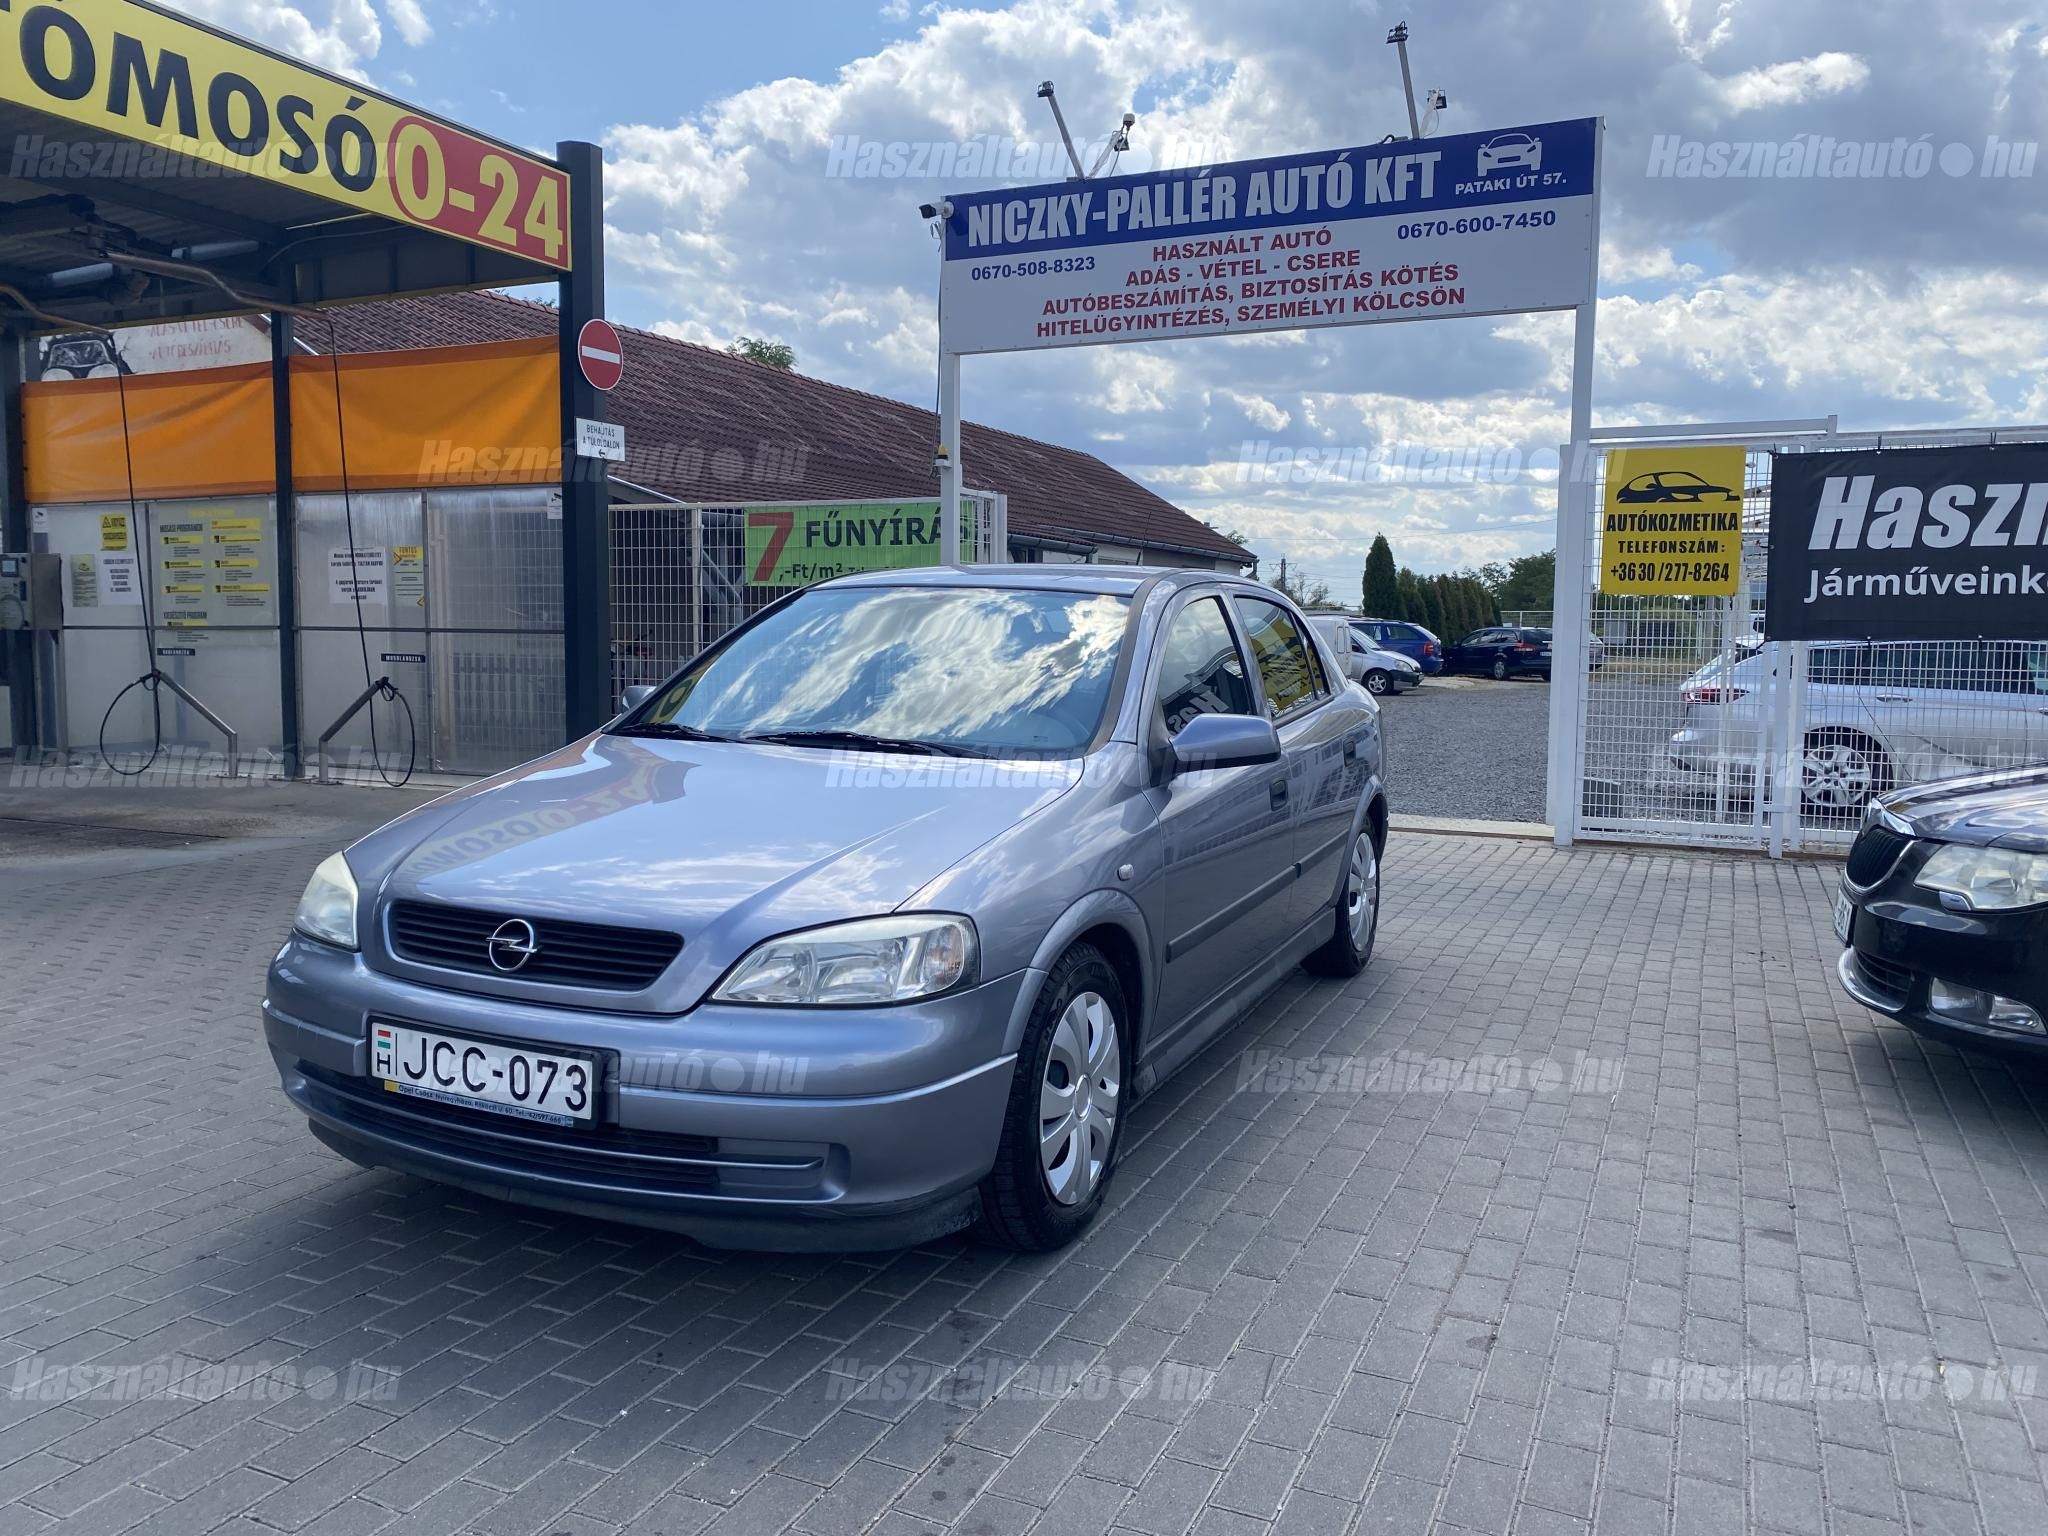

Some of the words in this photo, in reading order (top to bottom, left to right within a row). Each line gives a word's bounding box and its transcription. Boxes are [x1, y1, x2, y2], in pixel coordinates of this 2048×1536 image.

[968, 169, 1237, 248] NICZKY-PALLÉR
[1245, 152, 1353, 217] AUTÓ
[1365, 151, 1442, 205] KFT
[1455, 178, 1511, 195] PATAKI
[1516, 174, 1537, 189] ÚT
[1542, 172, 1567, 185] 57.
[1153, 234, 1264, 262] HASZNÁLT
[1270, 225, 1332, 251] AUTÓ
[1397, 209, 1556, 240] 0670-600-7450
[971, 256, 1096, 281] 0670-508-8323
[1126, 264, 1180, 287] ADÁS
[1200, 257, 1267, 281] VÉTEL
[1287, 249, 1360, 273] CSERE
[1043, 282, 1234, 316] AUTÓBESZÁMÍTÁS,
[1241, 269, 1372, 300] BIZTOSÍTÁS
[1381, 262, 1459, 287] KÖTÉS
[1037, 305, 1230, 338] HITELÜGYINTÉZÉS,
[1237, 297, 1345, 322] SZEMÉLYI
[1353, 287, 1465, 313] KÖLCSÖN
[1606, 510, 1739, 532] AUTÓKOZMETIKA
[749, 511, 794, 582] 7
[1804, 565, 2048, 604] Járműveink
[376, 1052, 391, 1074] H
[403, 1037, 587, 1112] JCC-073
